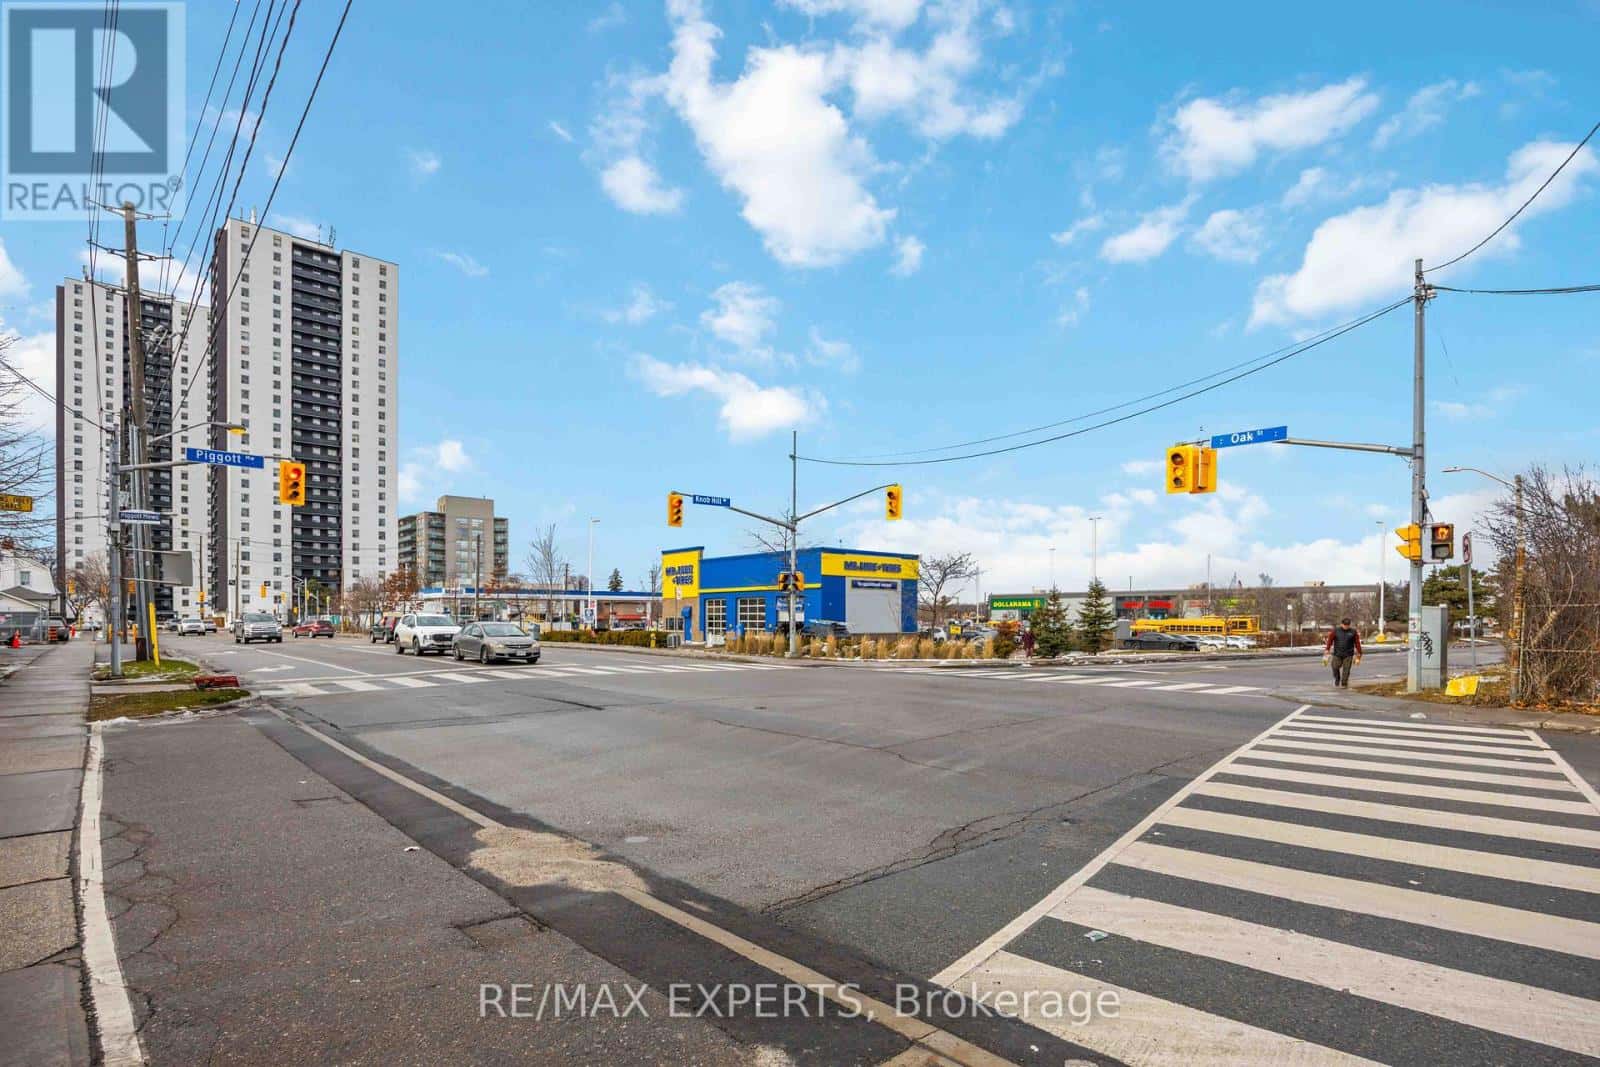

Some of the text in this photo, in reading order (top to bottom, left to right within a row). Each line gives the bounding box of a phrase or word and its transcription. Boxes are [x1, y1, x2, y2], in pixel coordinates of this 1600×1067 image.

[1231, 432, 1253, 444] Oak
[196, 449, 241, 464] Piggott
[711, 497, 722, 505] Hill
